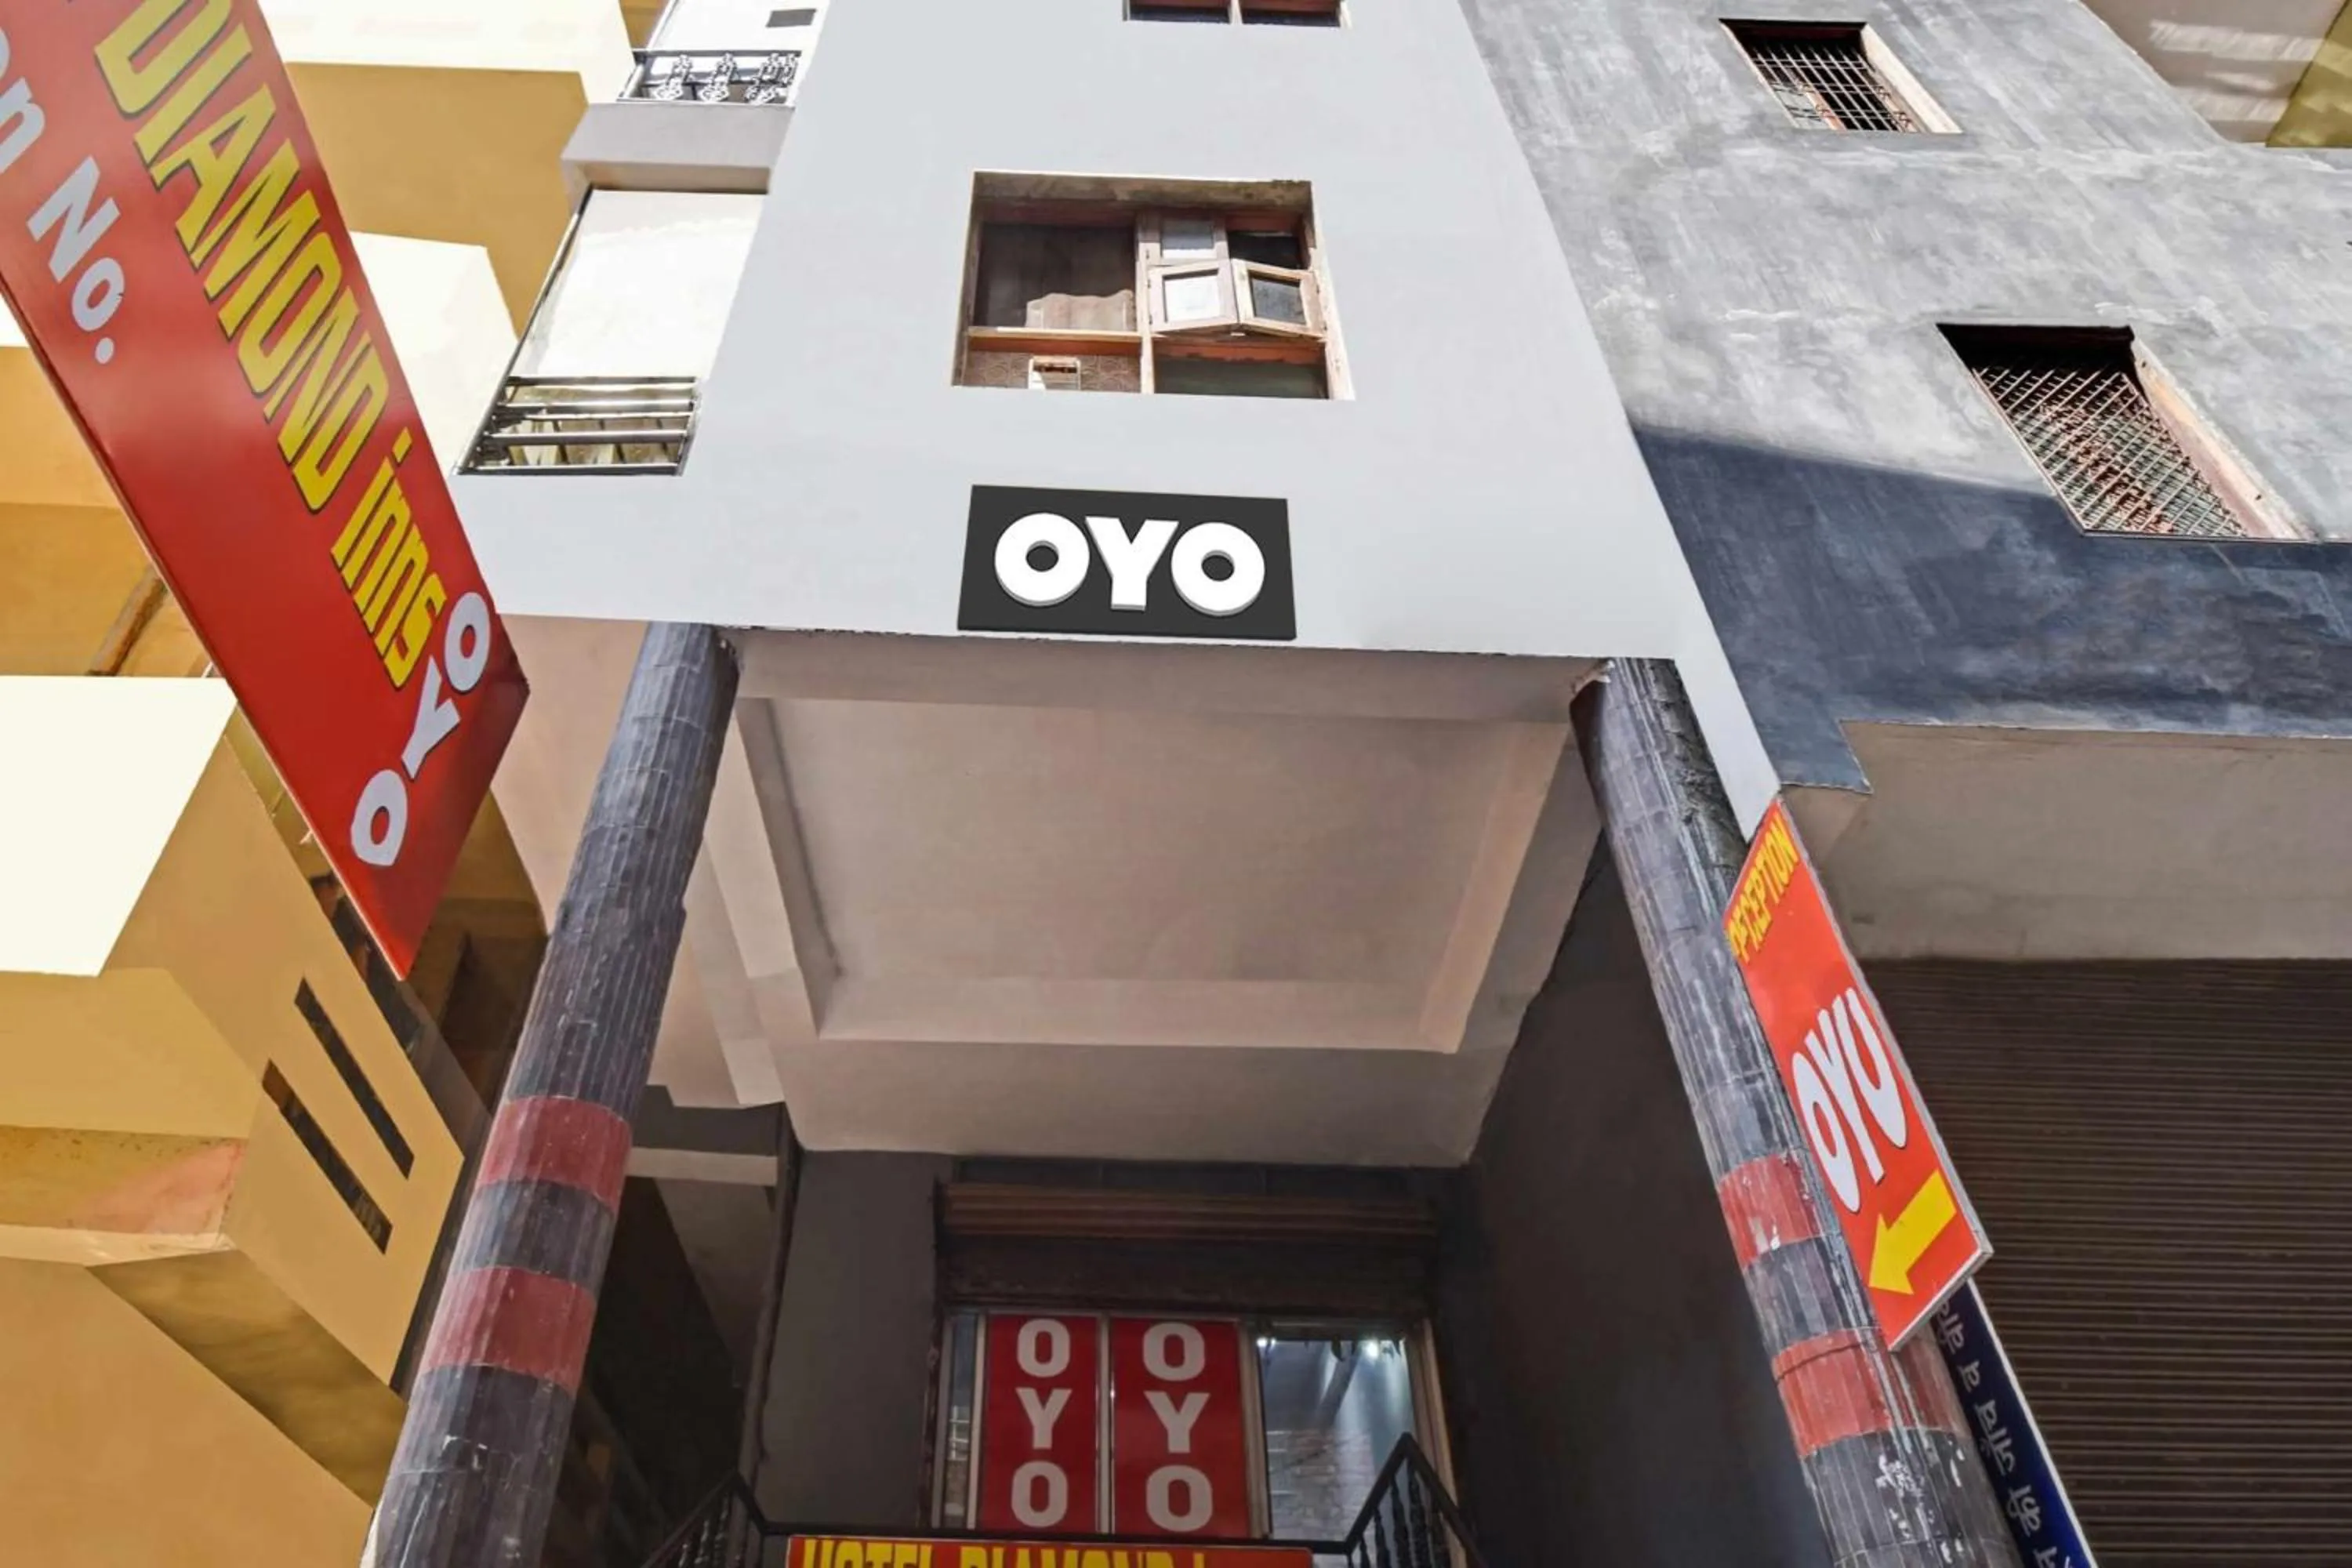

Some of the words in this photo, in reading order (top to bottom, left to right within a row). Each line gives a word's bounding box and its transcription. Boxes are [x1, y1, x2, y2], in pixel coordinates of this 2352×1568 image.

[27, 156, 125, 365] No.
[93, 0, 390, 514] DIAMOND
[994, 512, 1265, 617] OYO
[350, 592, 491, 866] OYO
[1011, 1319, 1072, 1528] OYO
[1142, 1323, 1214, 1533] OYO
[2008, 1484, 2042, 1537] की
